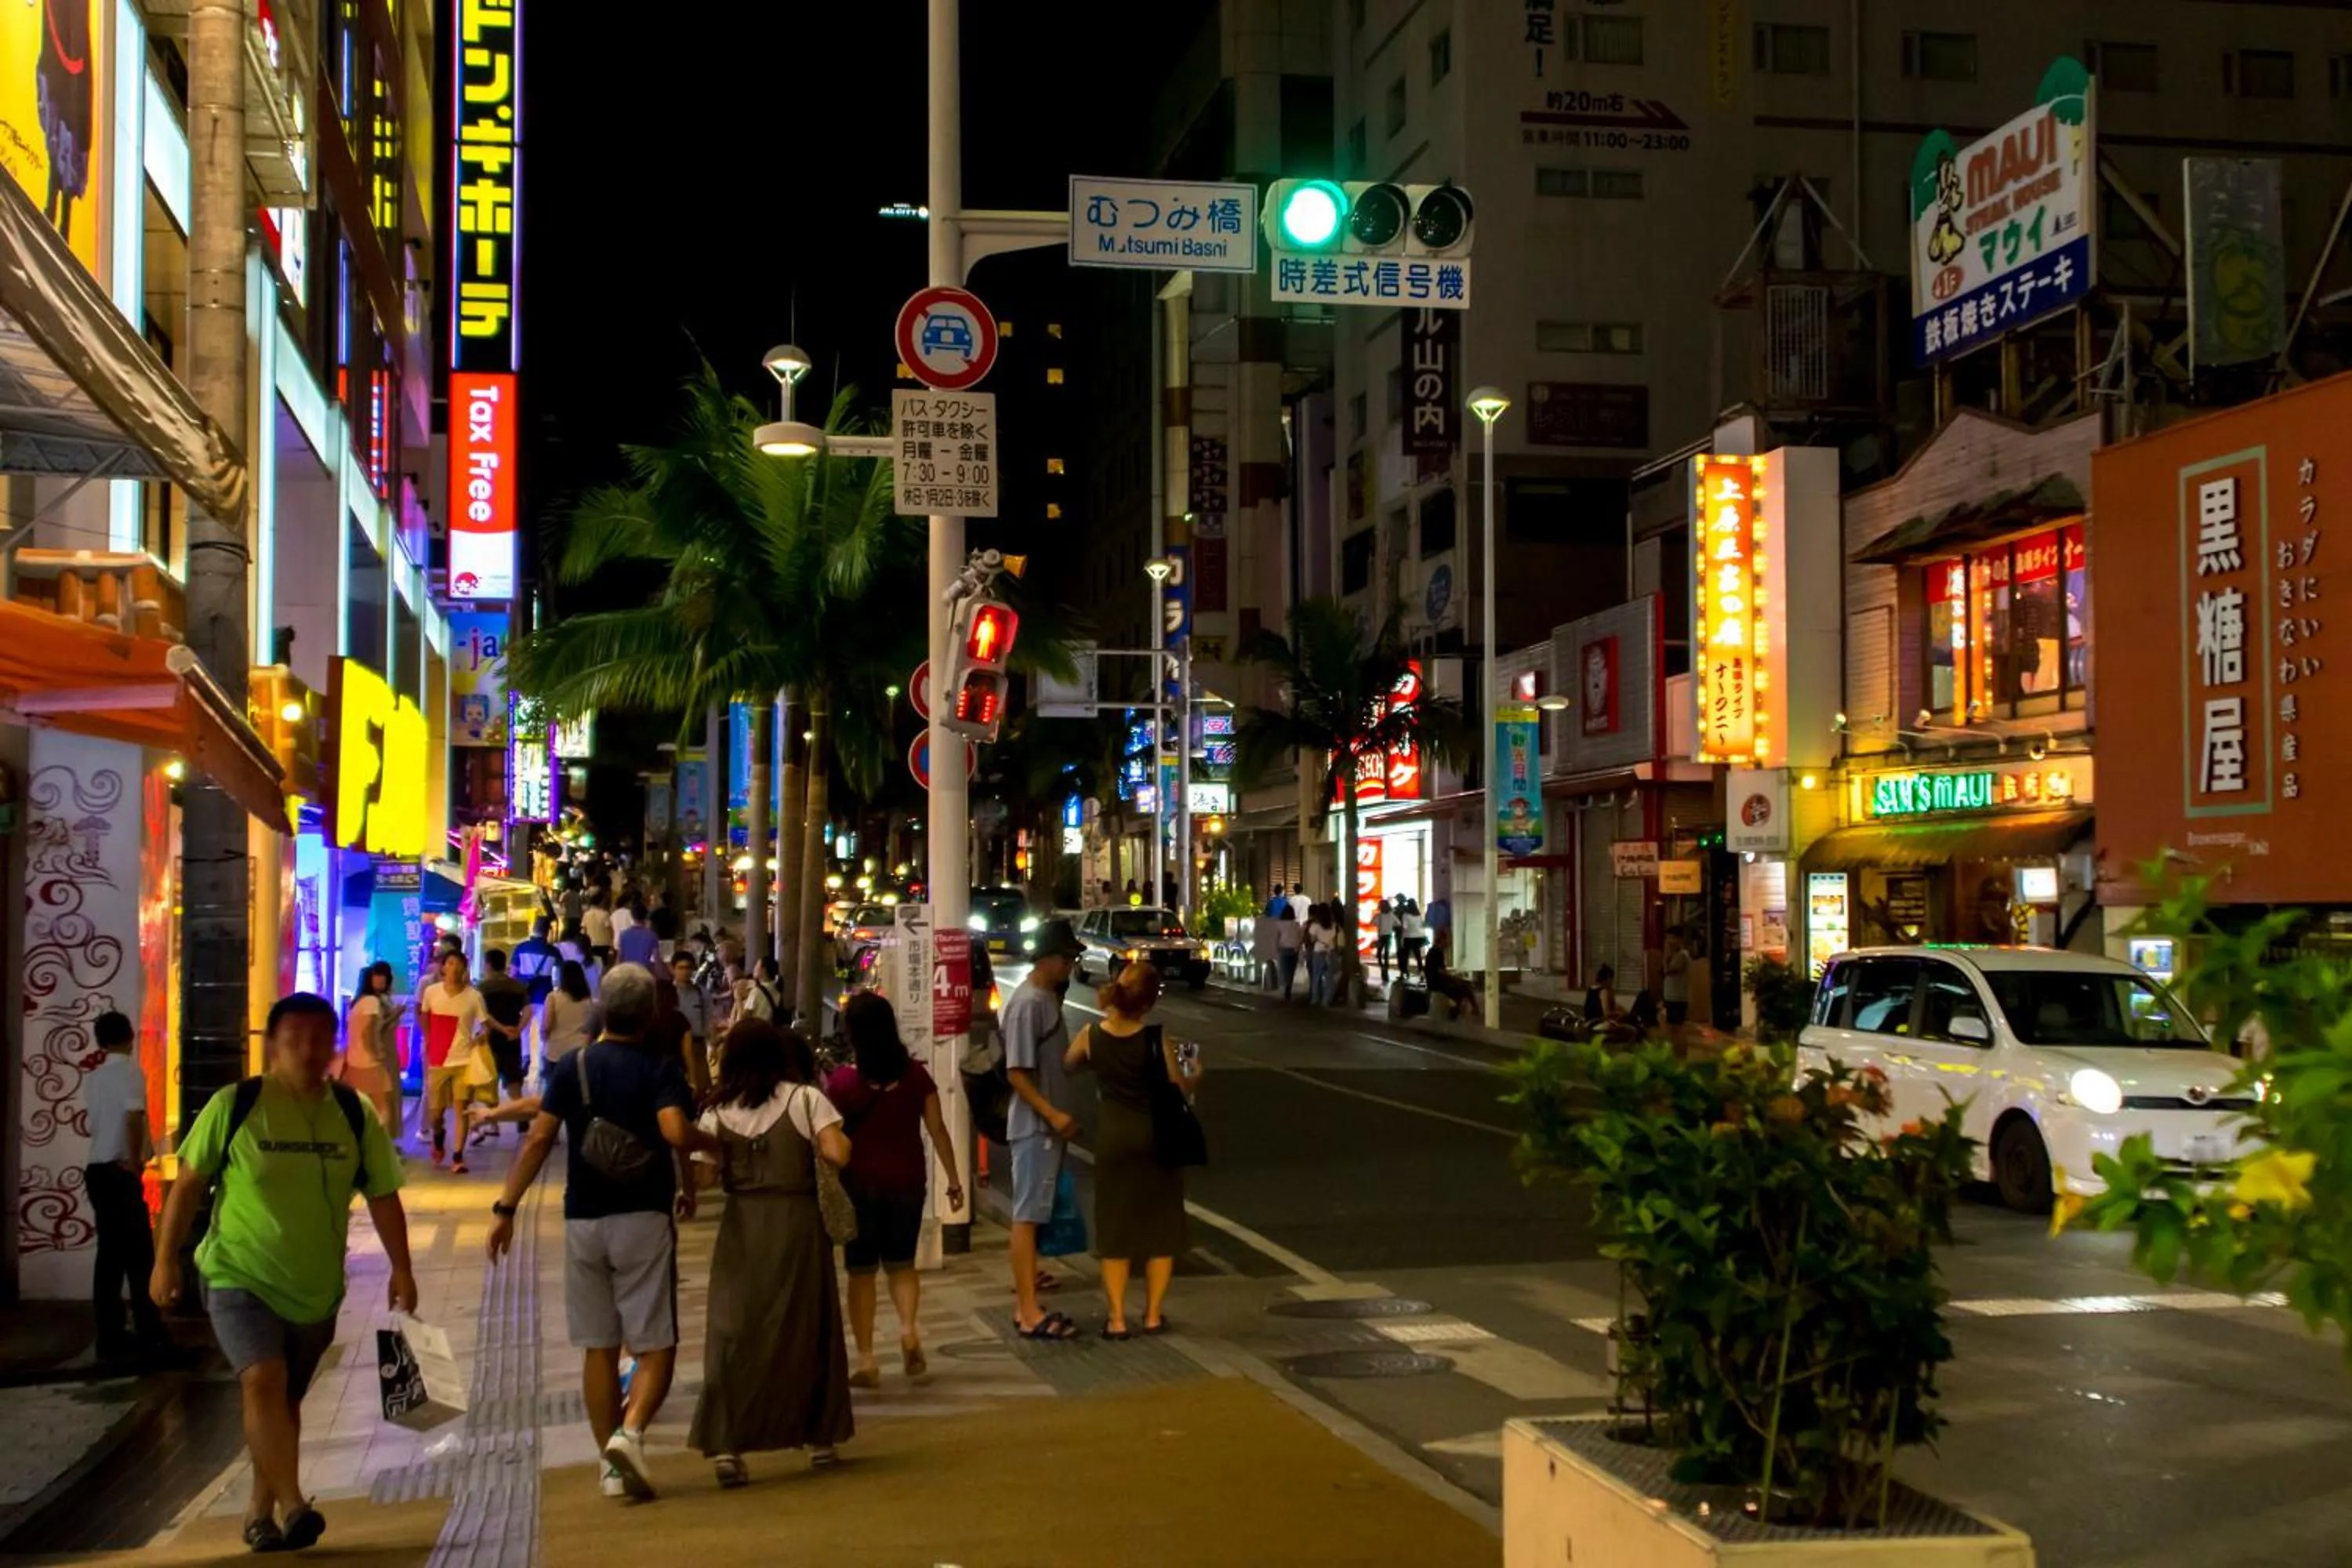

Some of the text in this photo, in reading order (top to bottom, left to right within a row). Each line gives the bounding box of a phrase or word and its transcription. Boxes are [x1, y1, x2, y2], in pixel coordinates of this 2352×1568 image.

[1967, 114, 2057, 208] MAUI
[1087, 195, 1242, 234] むつみ橋
[1980, 205, 2045, 273] マウイ
[1277, 258, 1465, 300] 時差式信号機
[1924, 253, 2074, 356] 鉄板焼きステーキ
[902, 398, 988, 419] バス・タクシー
[1413, 308, 1445, 436] ル山の内
[468, 385, 499, 521] Tax Free
[902, 419, 989, 440] 許可車を除く
[2298, 457, 2322, 677] カラダにいい
[2196, 476, 2245, 793] 黒糖屋
[2277, 539, 2299, 799] おきなわ県産品
[1934, 772, 1992, 808] MAUI
